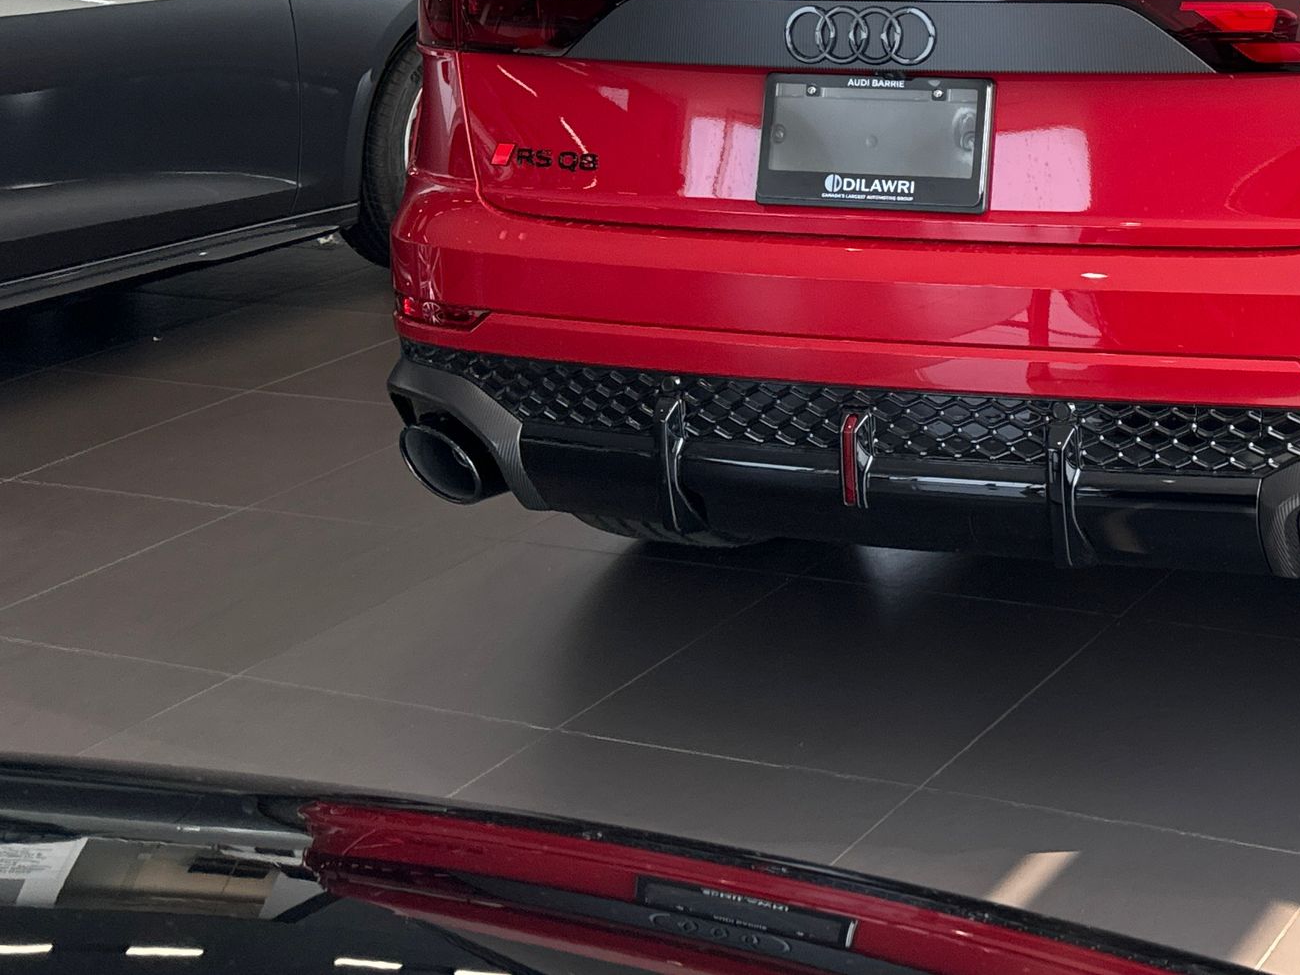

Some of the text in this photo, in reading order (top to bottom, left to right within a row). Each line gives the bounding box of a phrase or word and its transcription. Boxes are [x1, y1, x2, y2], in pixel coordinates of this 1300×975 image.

[847, 78, 905, 88] AUDI BARRIE
[516, 147, 599, 172] RS Q8
[842, 177, 915, 194] DILAWRI
